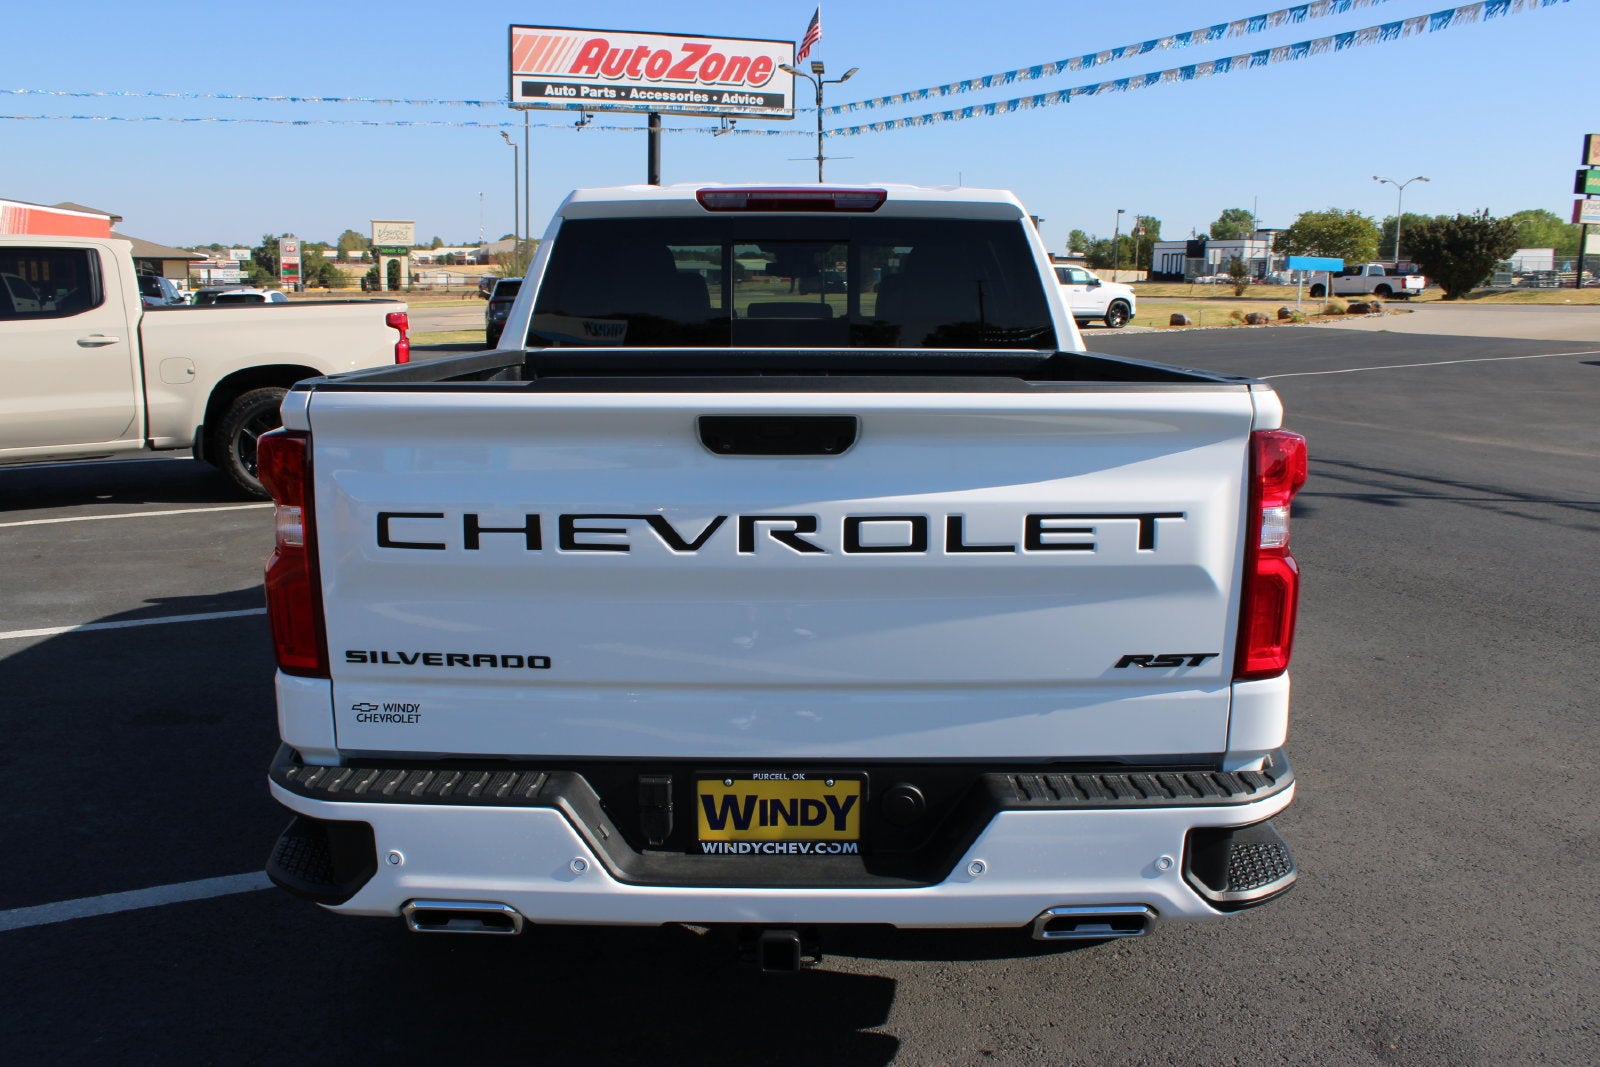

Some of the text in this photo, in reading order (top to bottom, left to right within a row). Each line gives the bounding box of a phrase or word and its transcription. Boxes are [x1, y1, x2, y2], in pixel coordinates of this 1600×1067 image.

[568, 37, 776, 87] AutoZone
[544, 84, 764, 105] Auto Parts Accessories Advice
[376, 511, 1185, 554] CHEVROLET
[345, 650, 552, 669] SILVERADO
[1113, 652, 1220, 669] RST
[383, 703, 420, 713] WINDY
[356, 713, 421, 724] CHEVROLET
[752, 773, 790, 781] PURCELL,
[701, 842, 859, 854] WINDYCHEV.COM
